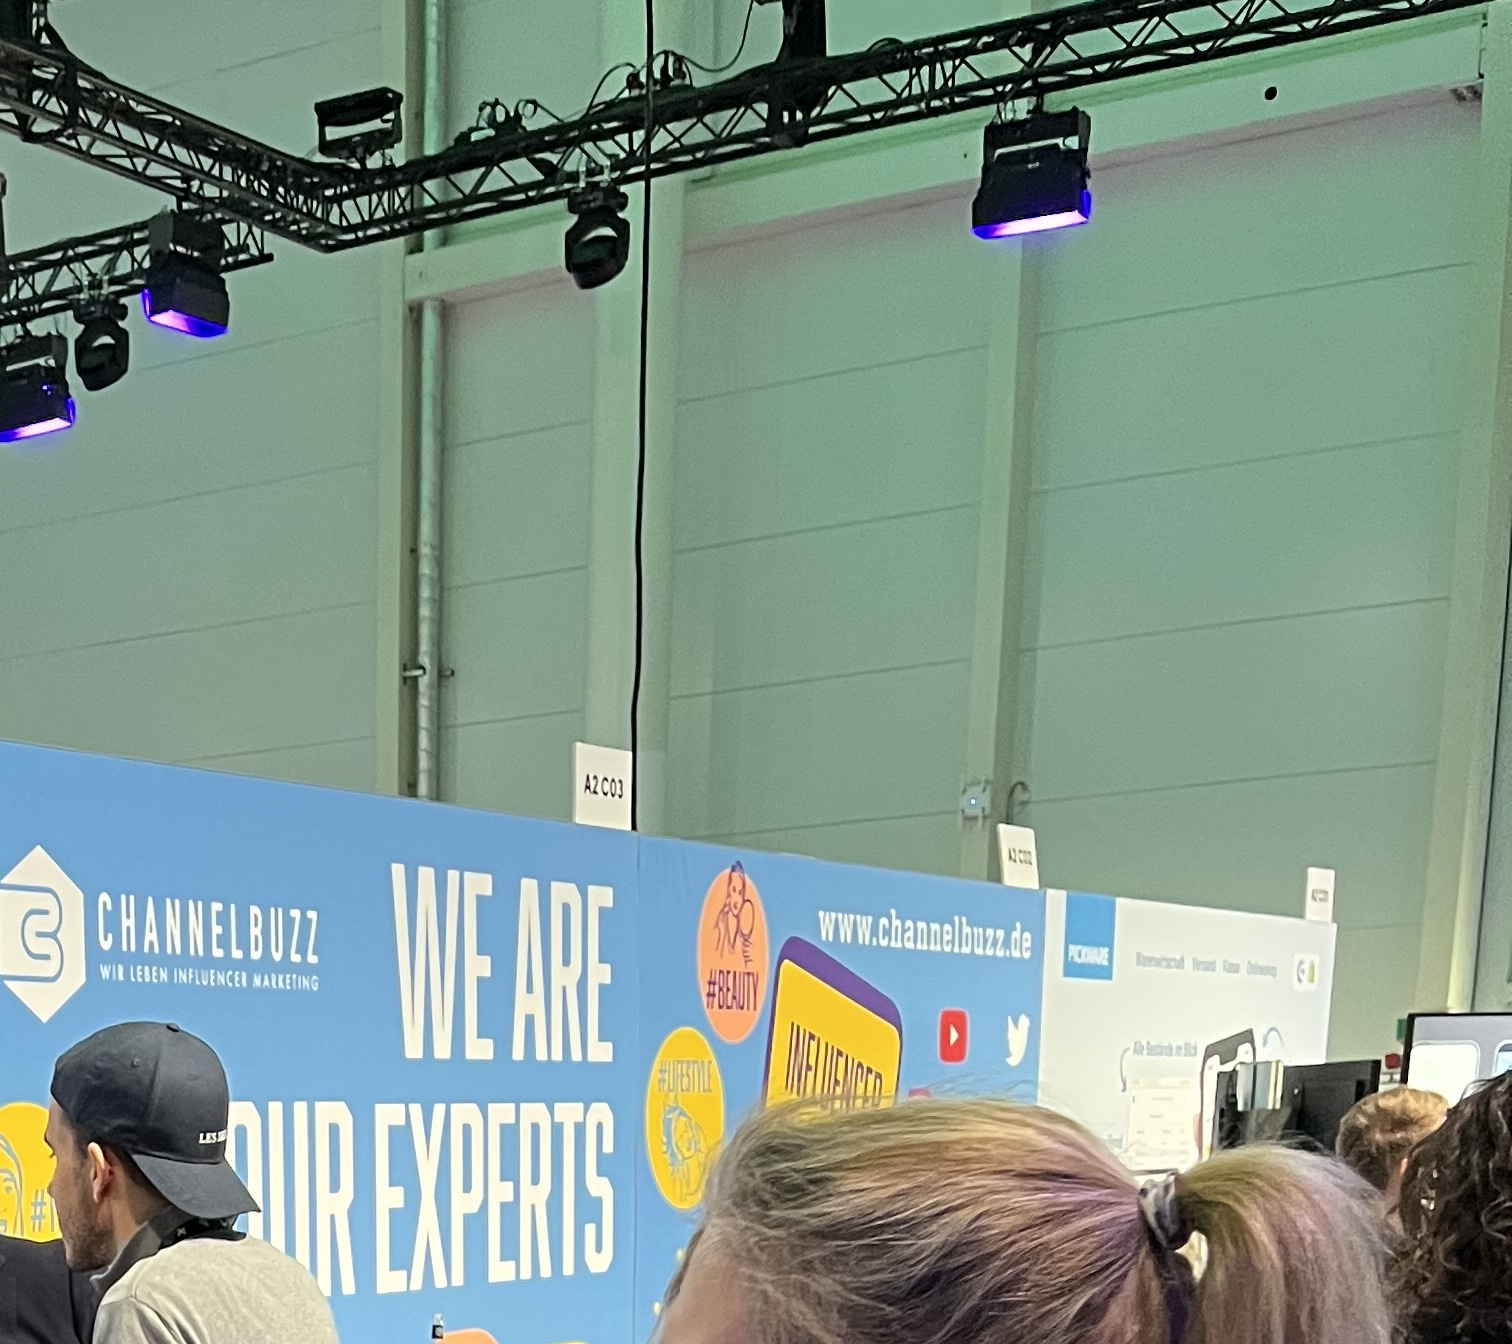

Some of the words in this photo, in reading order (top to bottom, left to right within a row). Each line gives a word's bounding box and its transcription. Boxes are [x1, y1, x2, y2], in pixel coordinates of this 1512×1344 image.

[583, 773, 601, 796] A2
[97, 891, 320, 964] CHANNELBUZZ
[818, 908, 1032, 960] www.channelbuzz.de
[99, 963, 127, 982] WIR
[130, 965, 169, 984] LEBEN
[173, 967, 249, 989] INFLUENCER
[252, 972, 320, 992] MARKETING
[391, 862, 494, 1061] WE
[513, 877, 614, 1063] ARE
[705, 967, 759, 1012] #BEAUTY
[658, 1059, 713, 1096] #LIFESTYLE
[374, 1100, 614, 1296] EXPERTS
